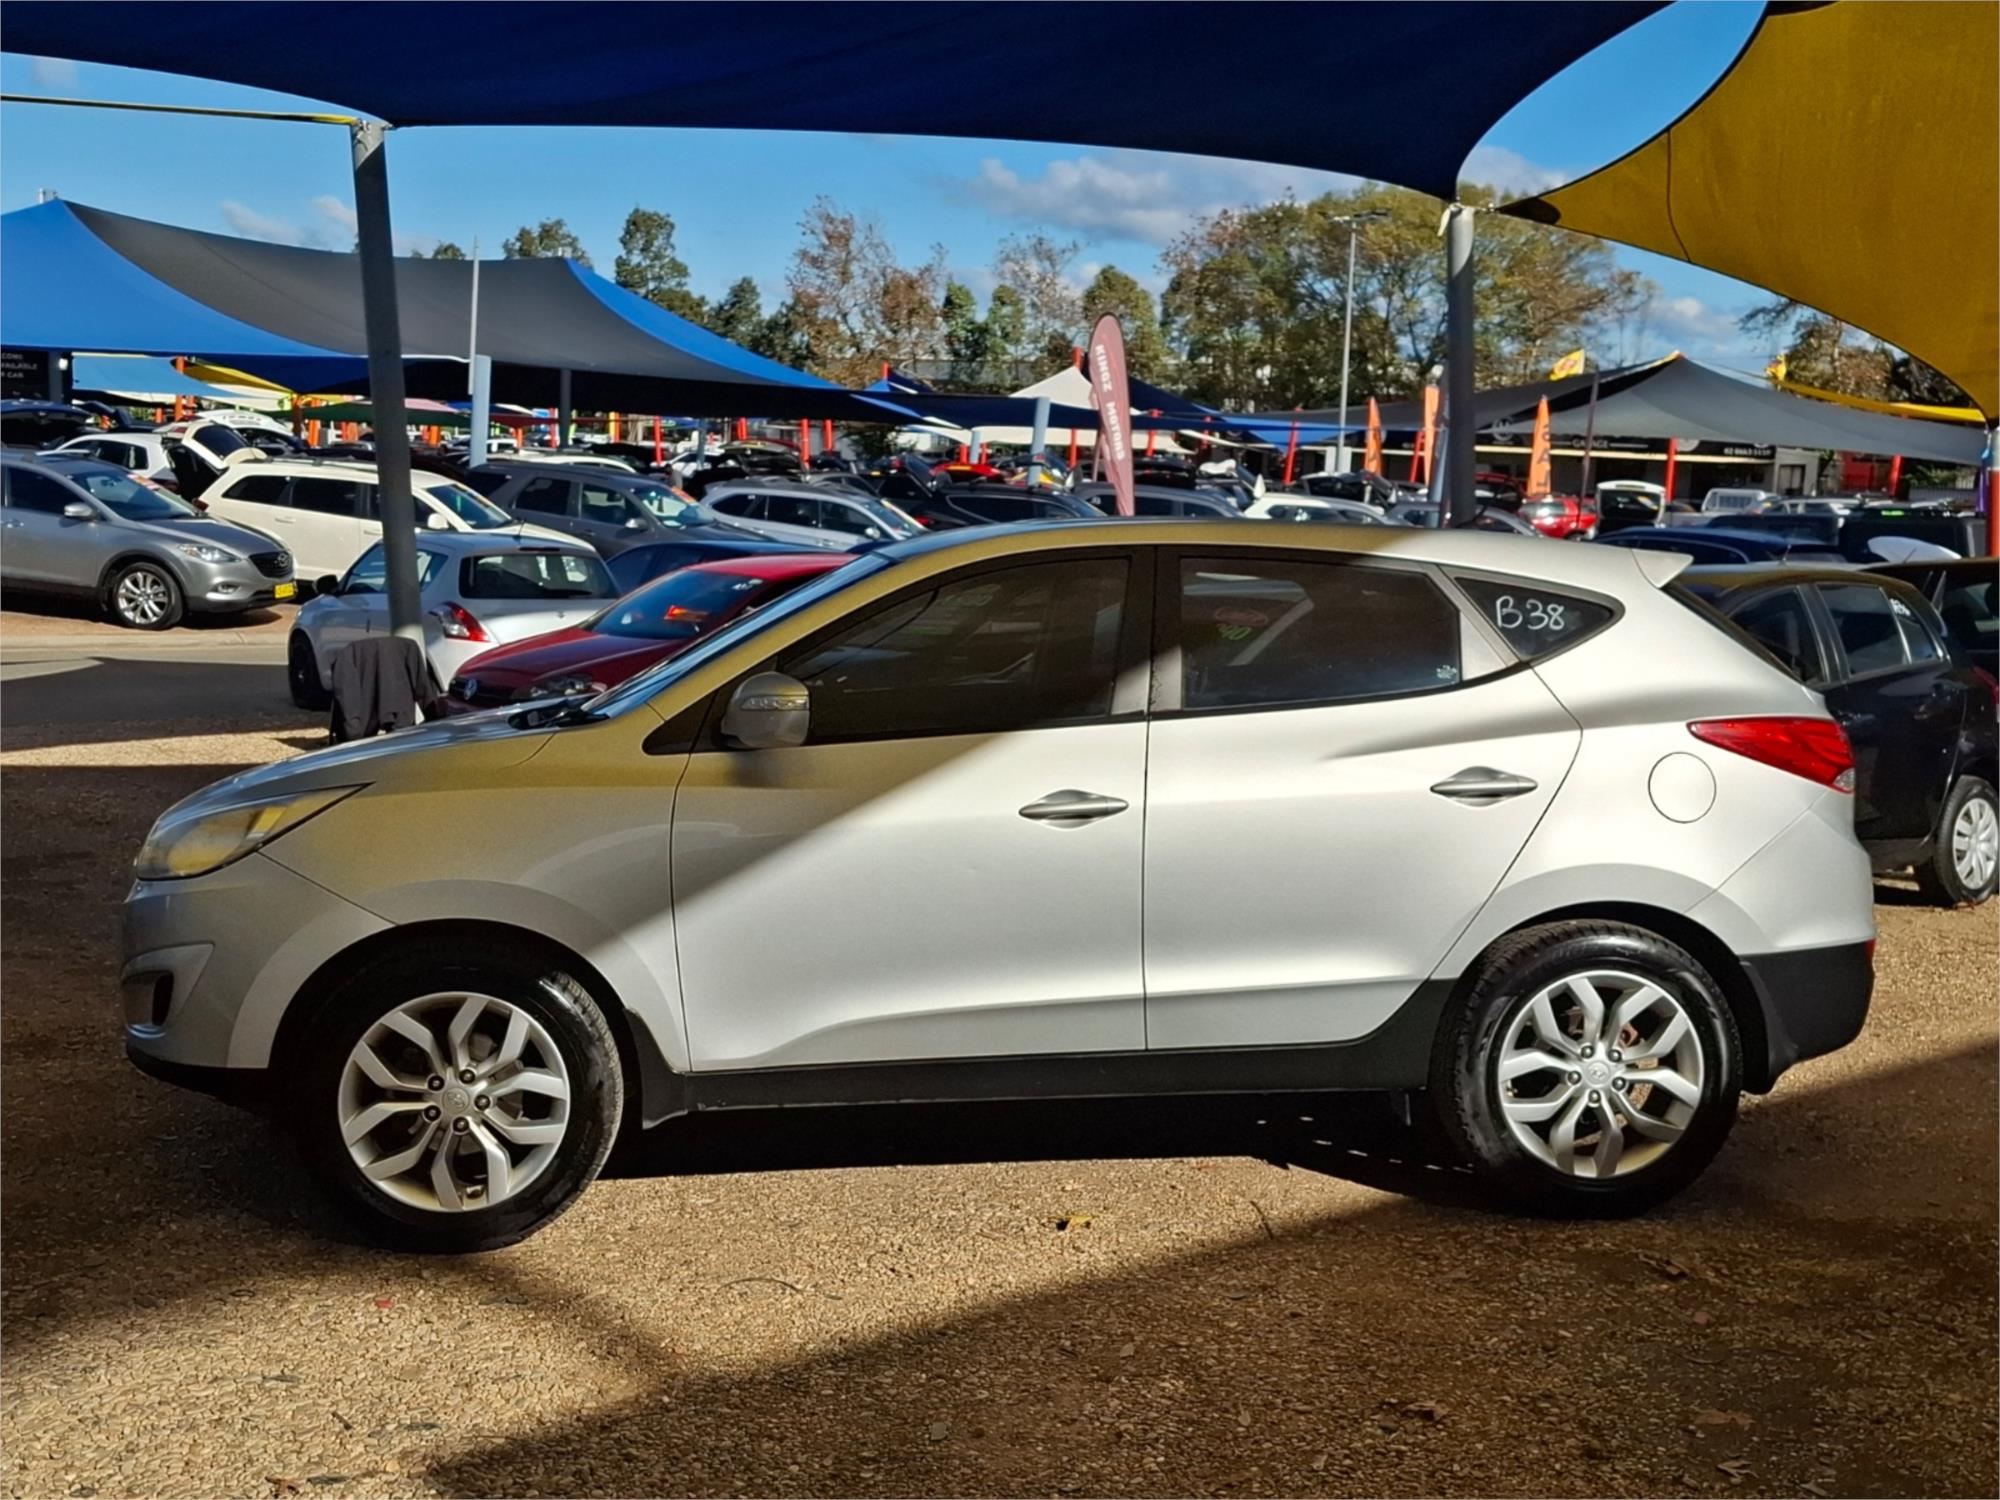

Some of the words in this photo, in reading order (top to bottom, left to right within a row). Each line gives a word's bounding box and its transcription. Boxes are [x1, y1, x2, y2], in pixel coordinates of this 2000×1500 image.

[1095, 344, 1113, 392] KINGZ
[1106, 401, 1125, 460] MOTORS
[1571, 438, 1609, 449] GAAGE
[1495, 594, 1565, 631] B38
